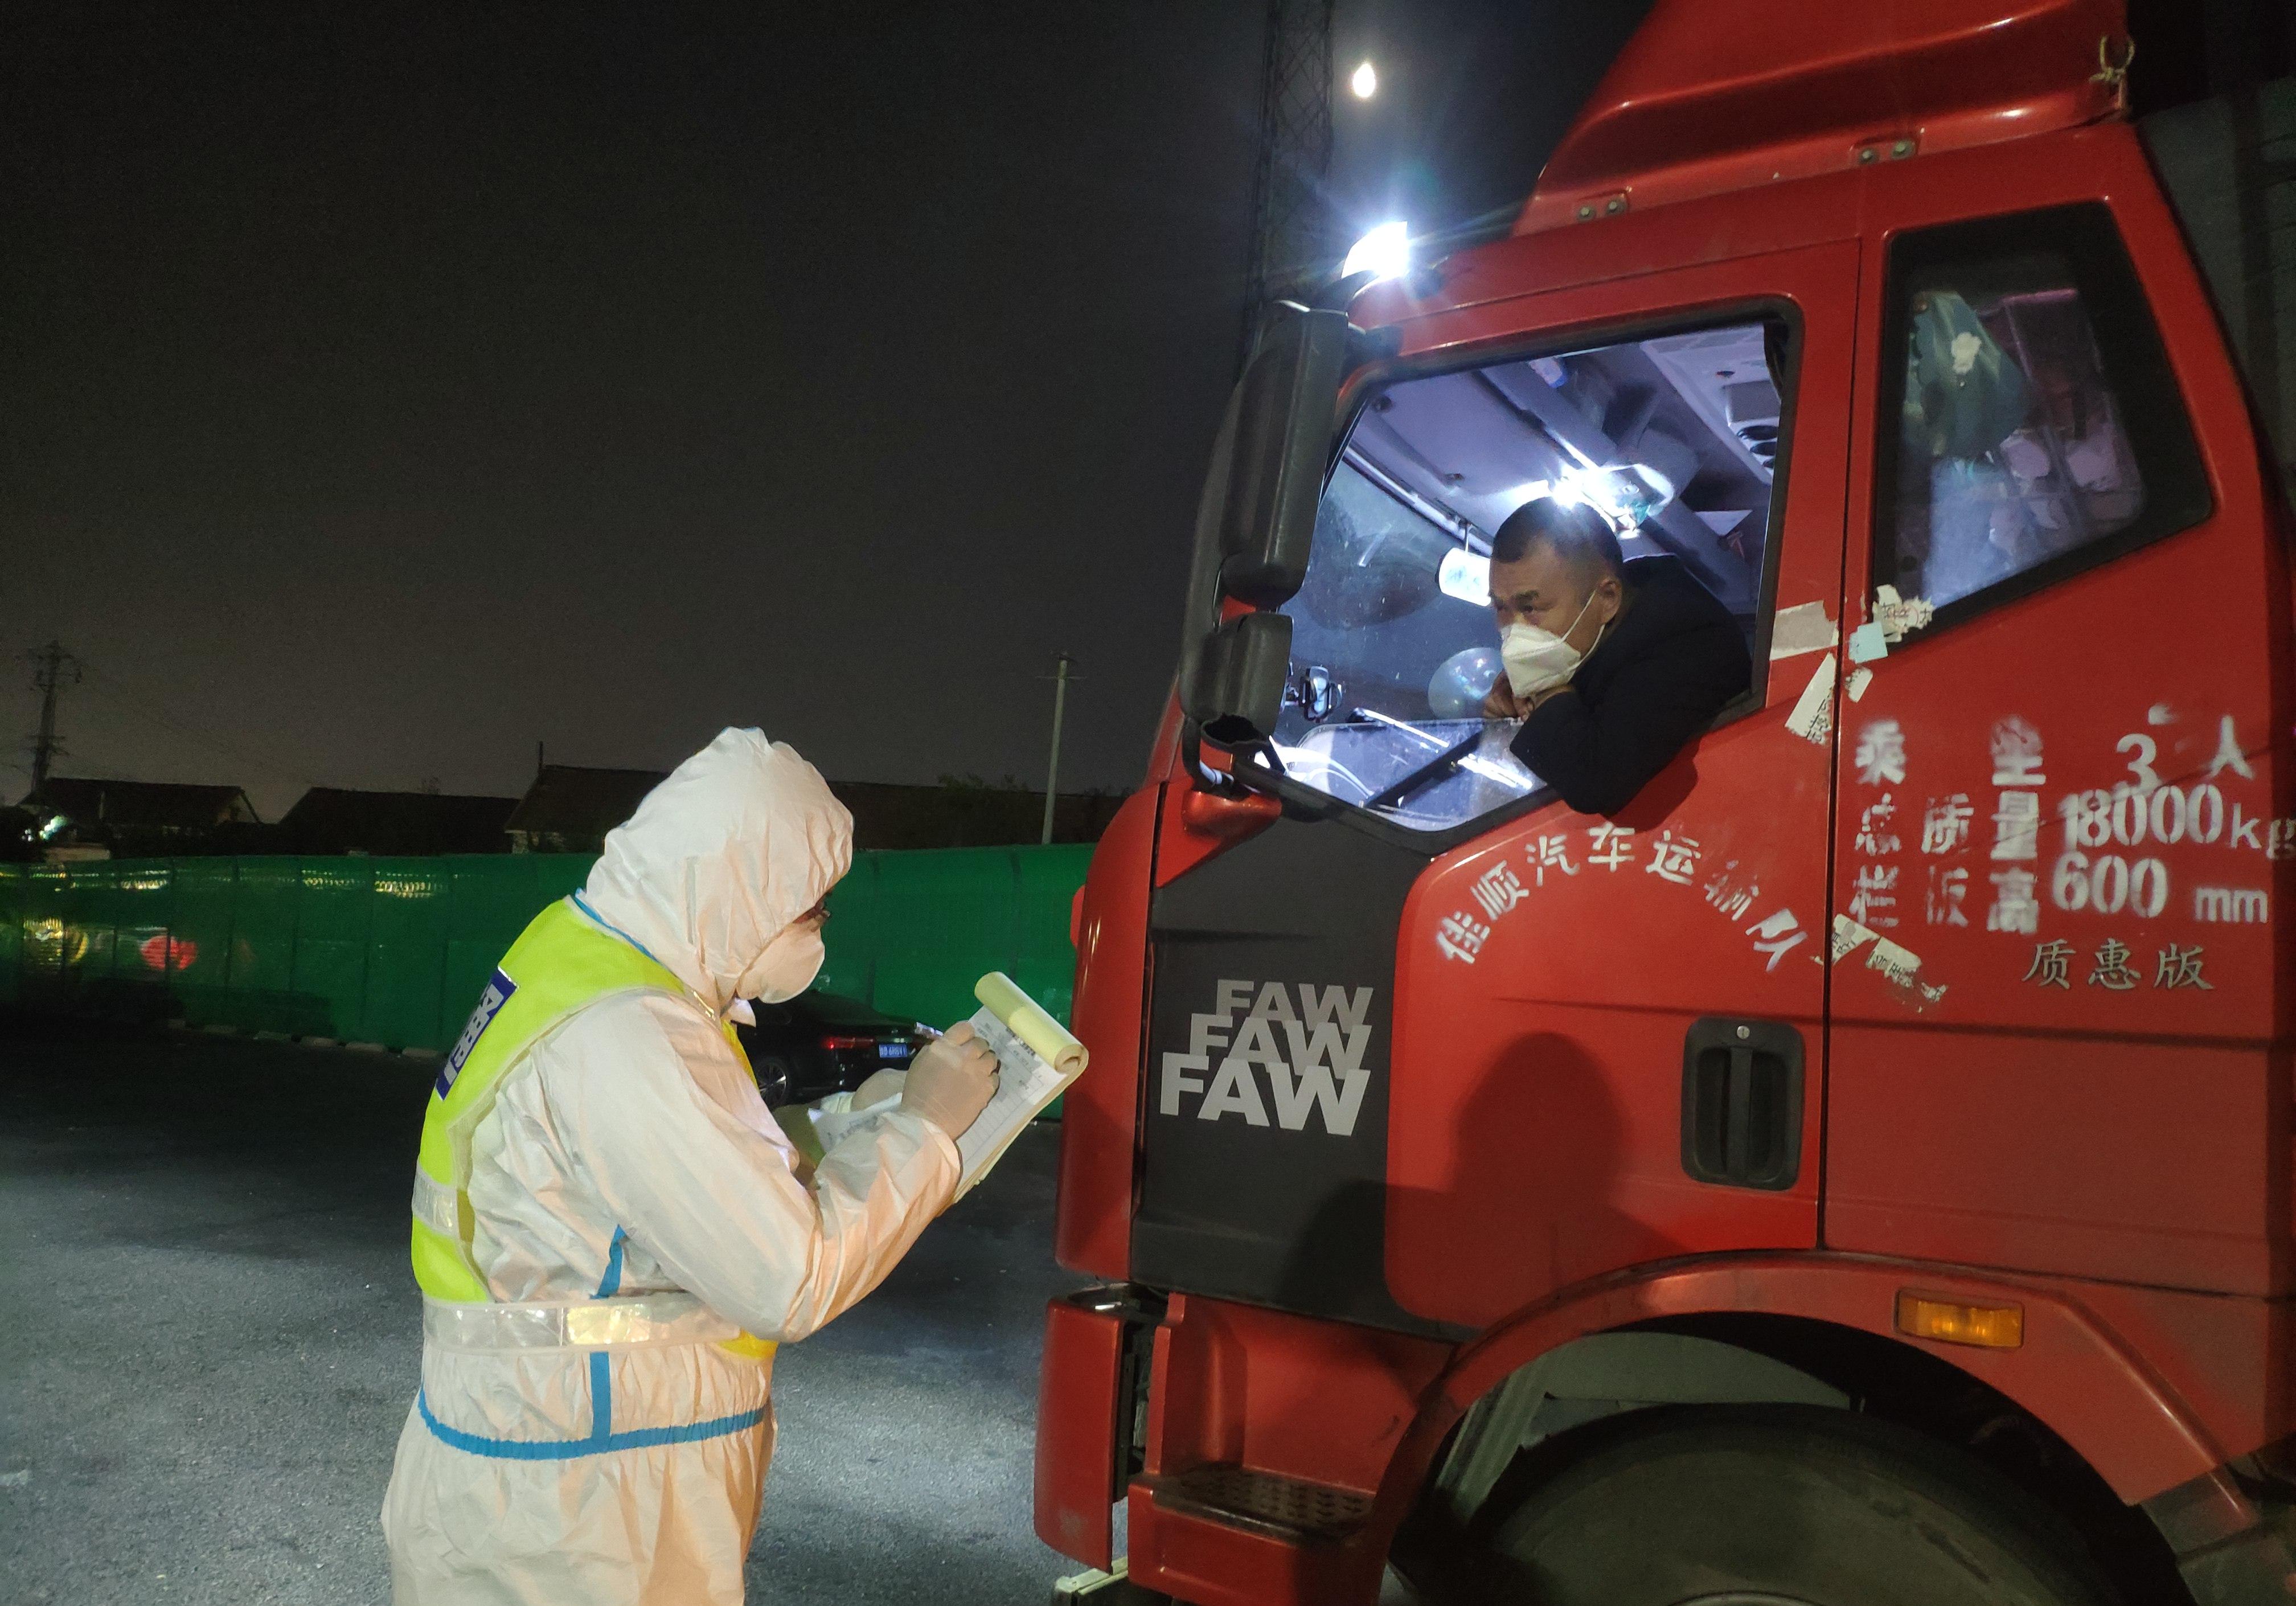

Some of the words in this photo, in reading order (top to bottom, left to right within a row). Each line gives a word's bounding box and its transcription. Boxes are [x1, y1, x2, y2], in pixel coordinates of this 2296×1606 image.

[2052, 850, 2168, 918] 600
[2195, 887, 2269, 924] mm
[2023, 937, 2215, 991] 质惠版
[1216, 978, 1374, 1034] FAW
[1189, 1013, 1372, 1080] FAW
[1160, 1051, 1371, 1137] FAW
